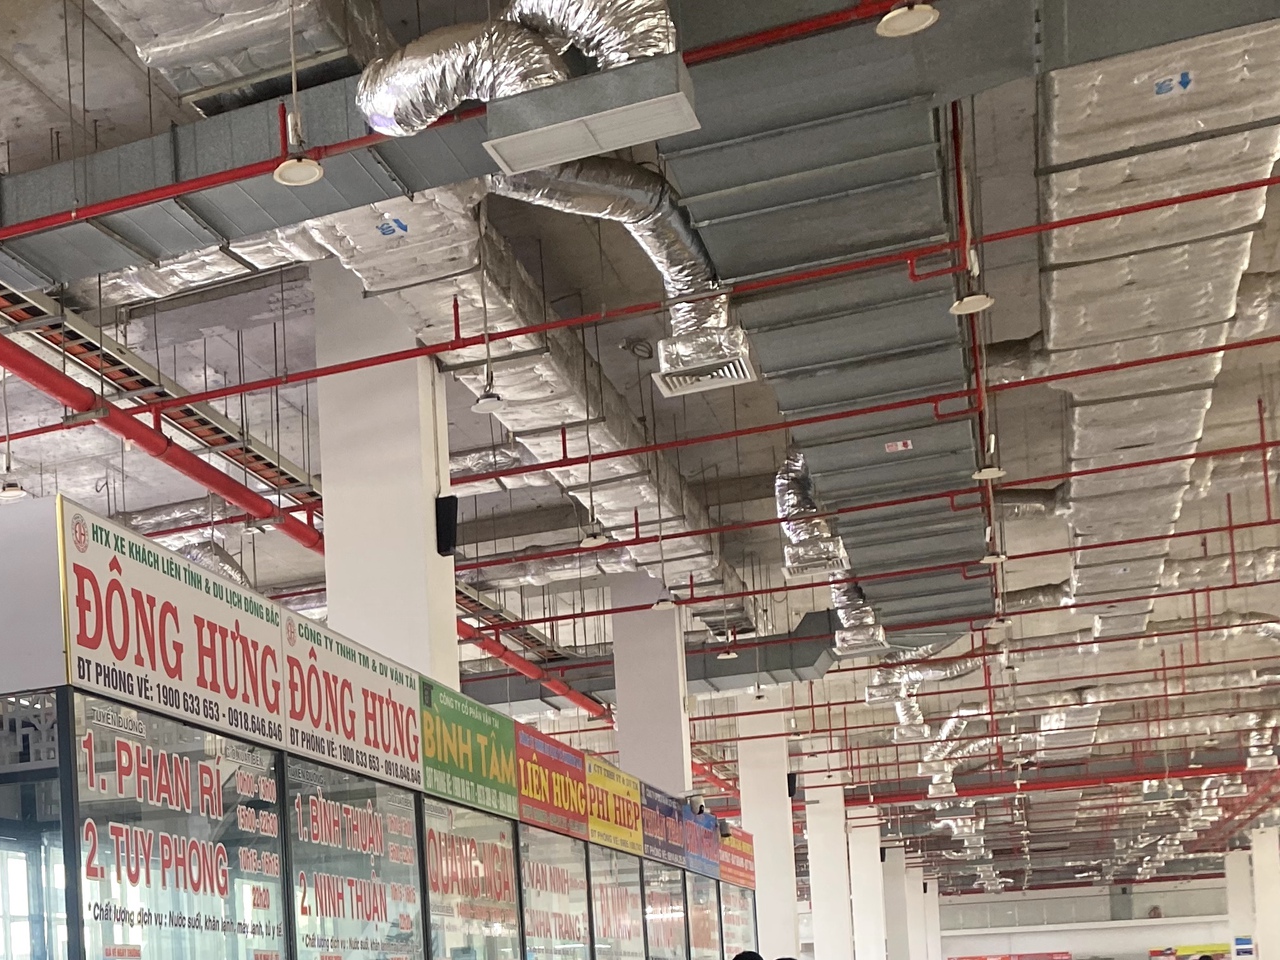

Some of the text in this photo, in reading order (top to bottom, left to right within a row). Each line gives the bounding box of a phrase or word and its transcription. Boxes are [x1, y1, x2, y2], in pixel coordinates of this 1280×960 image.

[92, 523, 111, 549] HTX
[113, 533, 126, 555] XE
[128, 540, 159, 571] KHÁCH
[161, 556, 181, 581] LIÊN
[183, 563, 202, 591] TỈNH
[205, 578, 211, 595] &
[213, 581, 223, 600] DU
[225, 587, 242, 610] LỊCH
[265, 604, 280, 627] BẮC
[73, 555, 280, 715] ĐÔNG HƯNG
[298, 623, 322, 646] CÔNG
[324, 635, 333, 652] TY
[335, 641, 356, 663] TNHH
[358, 652, 369, 669] TM
[371, 659, 377, 672] &
[379, 662, 388, 677] DV
[77, 656, 91, 682] ĐT
[95, 662, 134, 695] PHÒNG
[137, 674, 153, 701] VÉ:
[156, 683, 180, 709] 1900
[183, 692, 200, 716] 633
[202, 698, 220, 722] 653
[228, 707, 282, 742] 0918.646.646
[286, 646, 356, 741] ĐÔNG
[361, 688, 419, 763] HƯNG
[81, 728, 223, 821] 1. PHAN RÍ
[290, 727, 299, 746] ĐT
[301, 730, 325, 754] PHÒNG
[339, 744, 354, 764] 1900
[356, 749, 367, 768] 633
[368, 754, 380, 772] 653
[422, 703, 473, 773] BÌNH
[476, 730, 516, 787] TÂM
[519, 752, 549, 803] LIÊN
[552, 771, 586, 815] HƯNG
[309, 786, 342, 848] BÌNH
[342, 798, 384, 866] THUẬN
[587, 783, 610, 822] PHI
[613, 790, 640, 837] HIỆP
[83, 817, 229, 899] 2. TUY PHONG
[427, 808, 480, 898] QUẢNG
[93, 901, 112, 921] Chất
[113, 904, 134, 928] lượng
[136, 907, 152, 927] dịch
[154, 912, 163, 931] vụ
[313, 871, 345, 918] NINH
[346, 869, 388, 931] THUẬN
